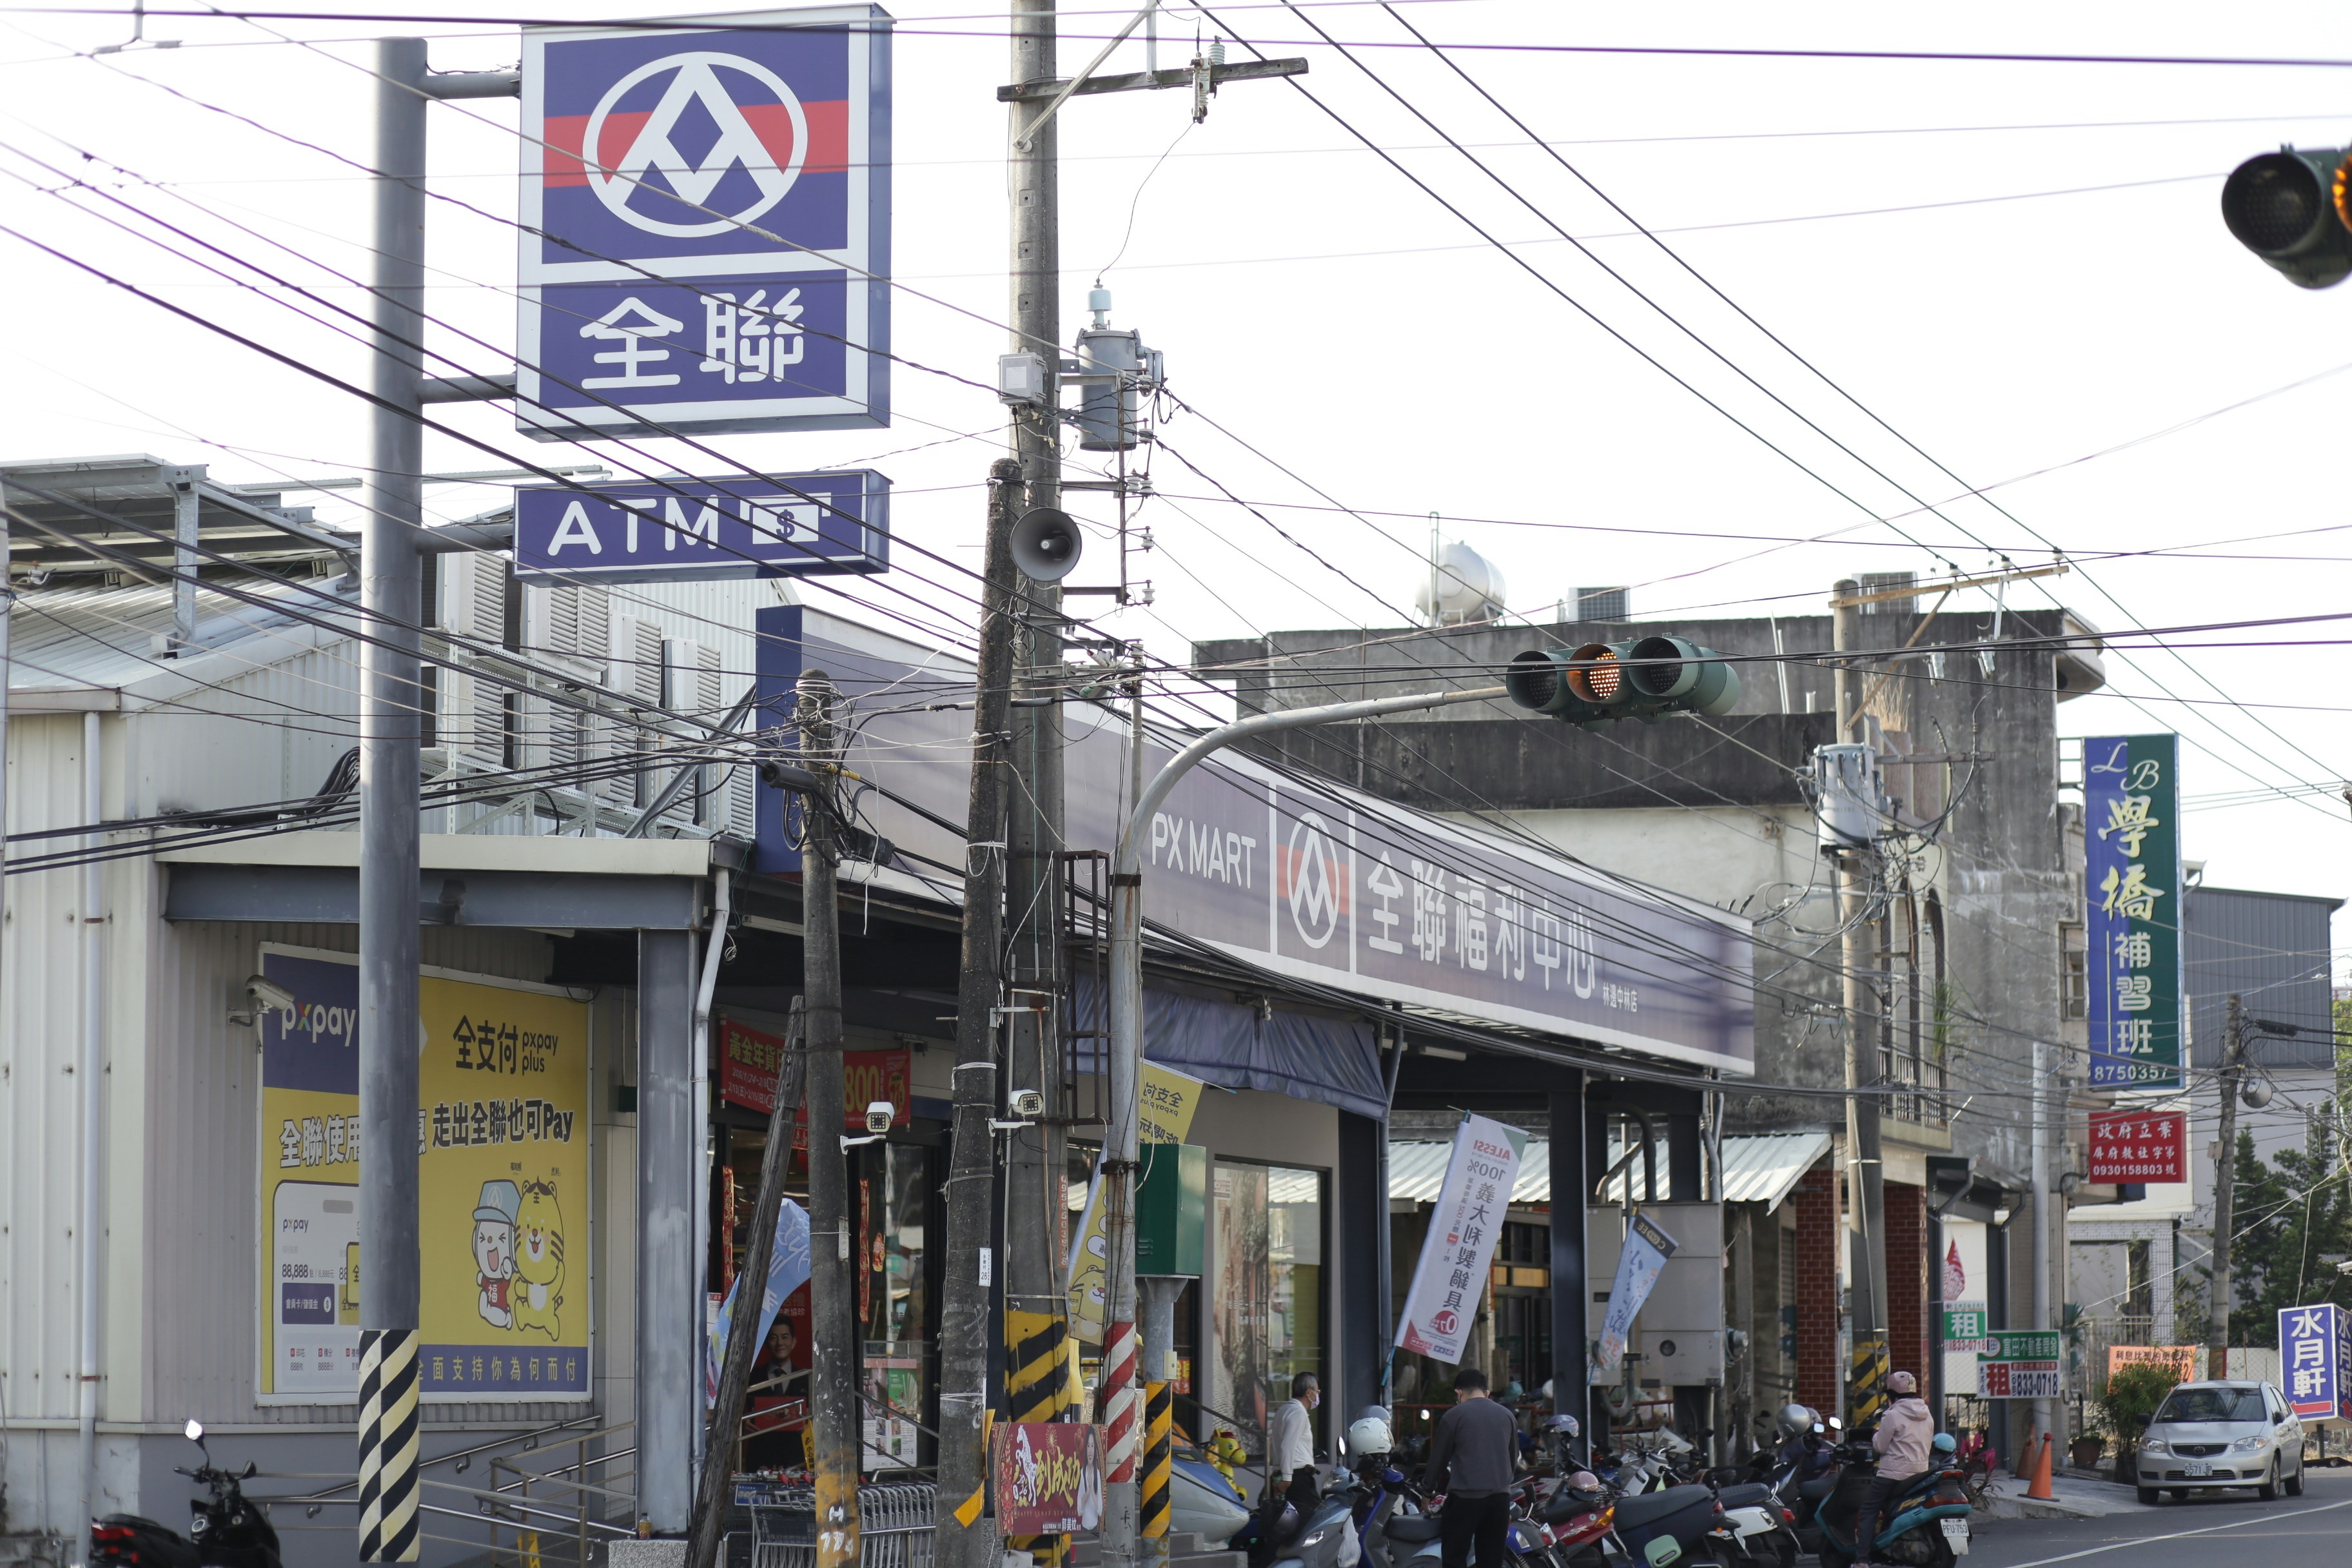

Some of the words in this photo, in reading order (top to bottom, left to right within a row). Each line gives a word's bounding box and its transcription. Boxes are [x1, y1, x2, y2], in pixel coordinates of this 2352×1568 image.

[580, 287, 805, 389] 全聯
[547, 494, 720, 556] ATM
[1152, 812, 1184, 872] PX
[1189, 816, 1257, 890] MART
[2098, 795, 2164, 921] 學橋
[1367, 850, 1596, 1000] 全聯福利中心
[1602, 981, 1638, 1013] 林邊中林店
[2115, 932, 2153, 1055] 補習班
[282, 1003, 356, 1046] pxpay
[453, 1014, 518, 1075] 全支付
[522, 1032, 558, 1056] pxpay
[522, 1050, 545, 1075] plus
[2094, 1064, 2168, 1081] 8750357
[431, 1097, 574, 1148] 走出全聯也可Pay
[2097, 1121, 2173, 1139] 政府立案
[282, 1264, 308, 1280] 88,888
[488, 1284, 498, 1302] 福
[1951, 1312, 1980, 1338] 租
[2291, 1309, 2327, 1398] 水月軒
[2338, 1311, 2352, 1398] 水月軒
[1986, 1362, 2011, 1397] 租
[2017, 1373, 2058, 1396] 833-0718
[1035, 1446, 1081, 1508] 到成功
